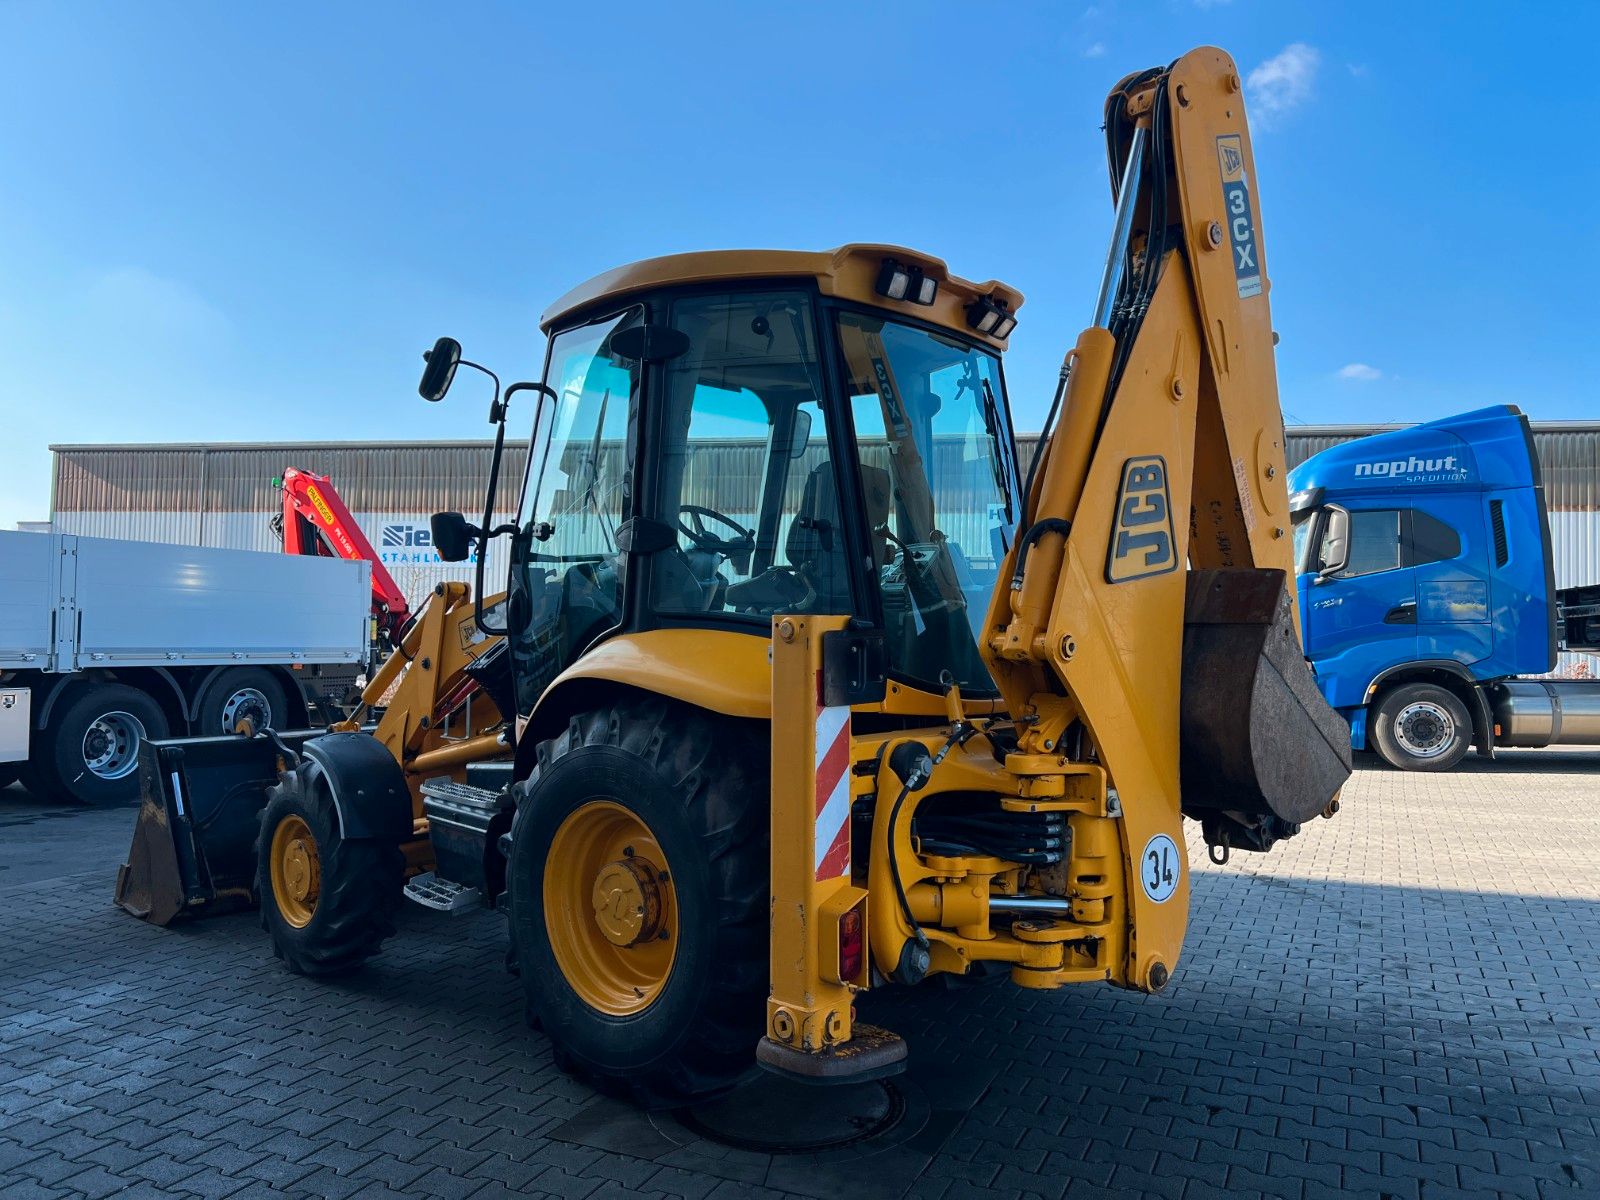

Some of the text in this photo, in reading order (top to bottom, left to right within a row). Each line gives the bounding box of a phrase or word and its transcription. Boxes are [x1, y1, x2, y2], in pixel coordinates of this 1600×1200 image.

[1229, 189, 1255, 270] 3CX
[1354, 455, 1457, 477] nophut
[1406, 473, 1467, 483] SPEDITION
[308, 487, 332, 523] PALFINGER
[1116, 464, 1171, 566] JCB
[1148, 846, 1173, 890] 34
